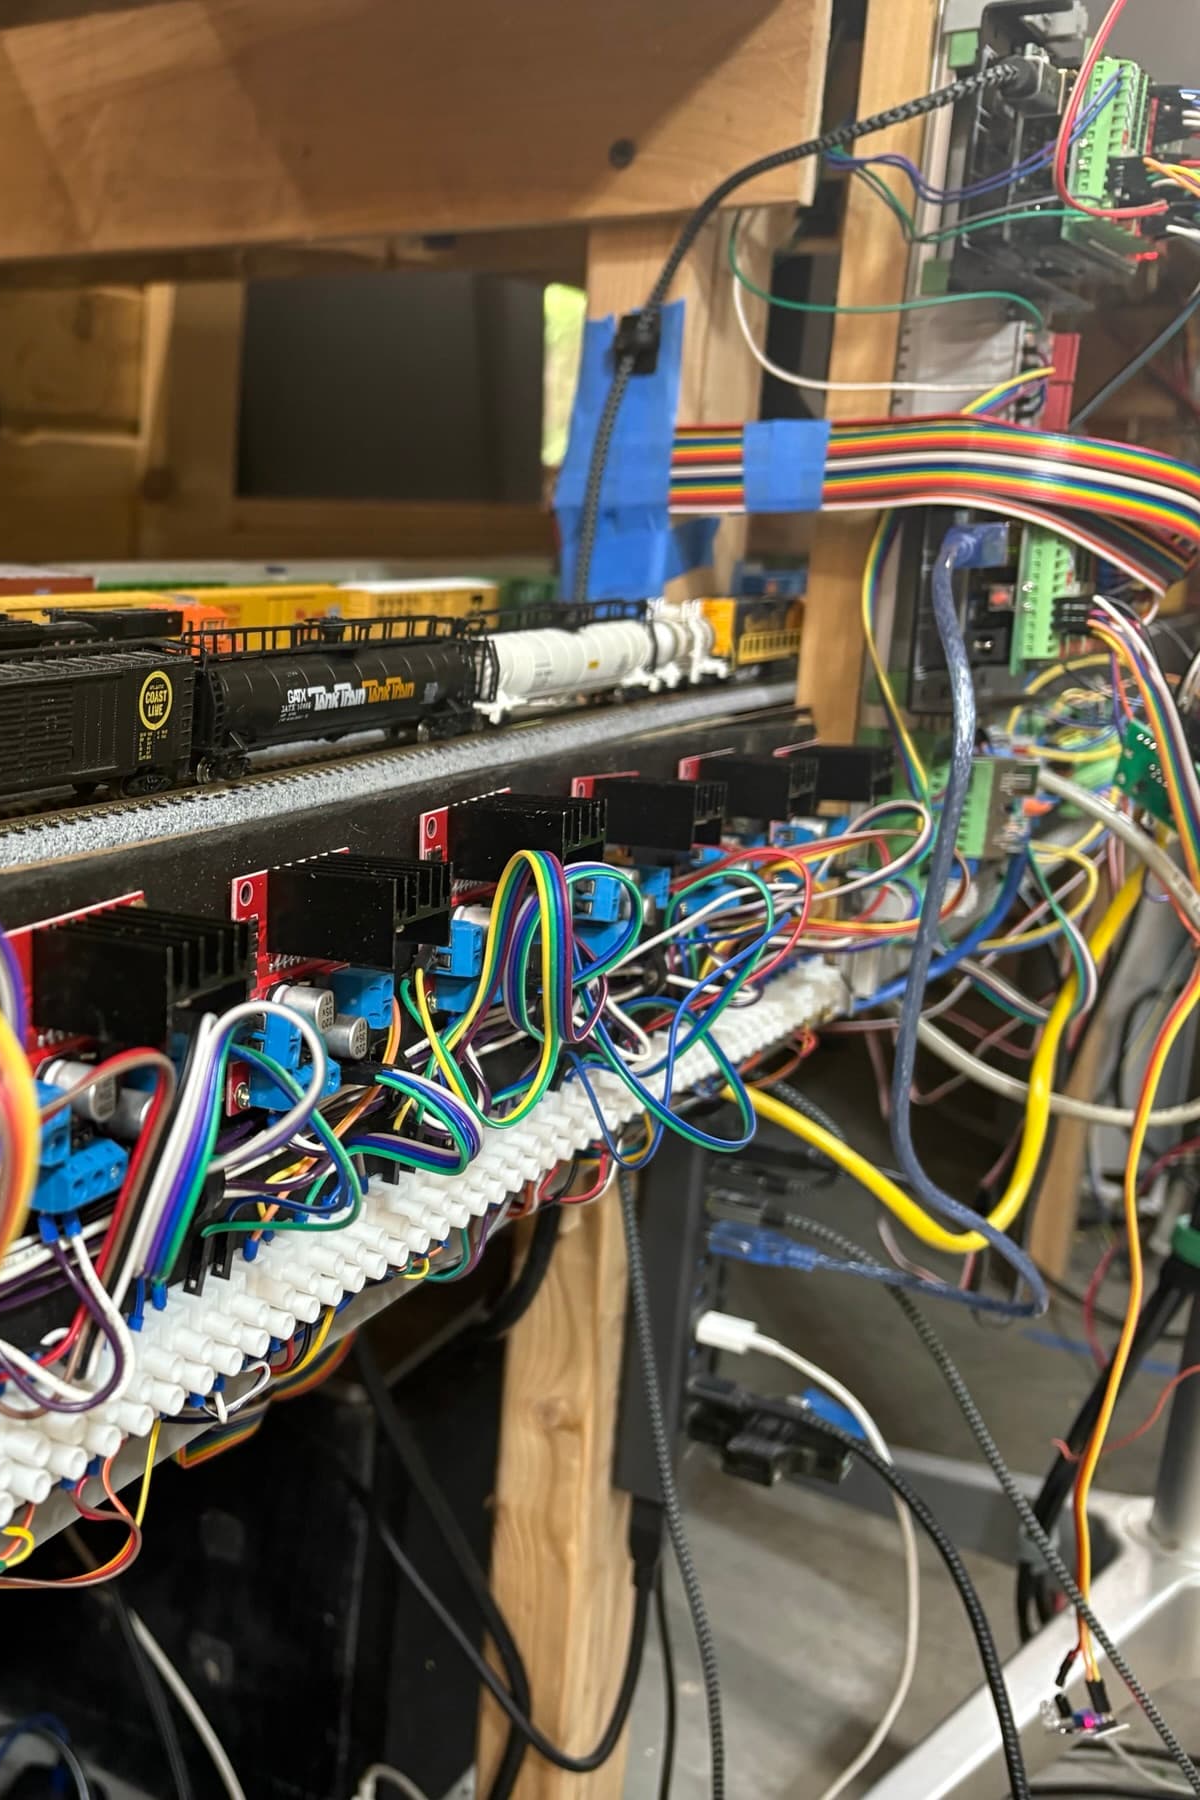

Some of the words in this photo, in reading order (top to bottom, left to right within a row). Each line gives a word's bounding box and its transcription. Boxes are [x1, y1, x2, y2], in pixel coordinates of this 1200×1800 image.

[145, 690, 168, 704] COAST
[287, 688, 307, 704] GATX
[147, 703, 164, 717] LINE
